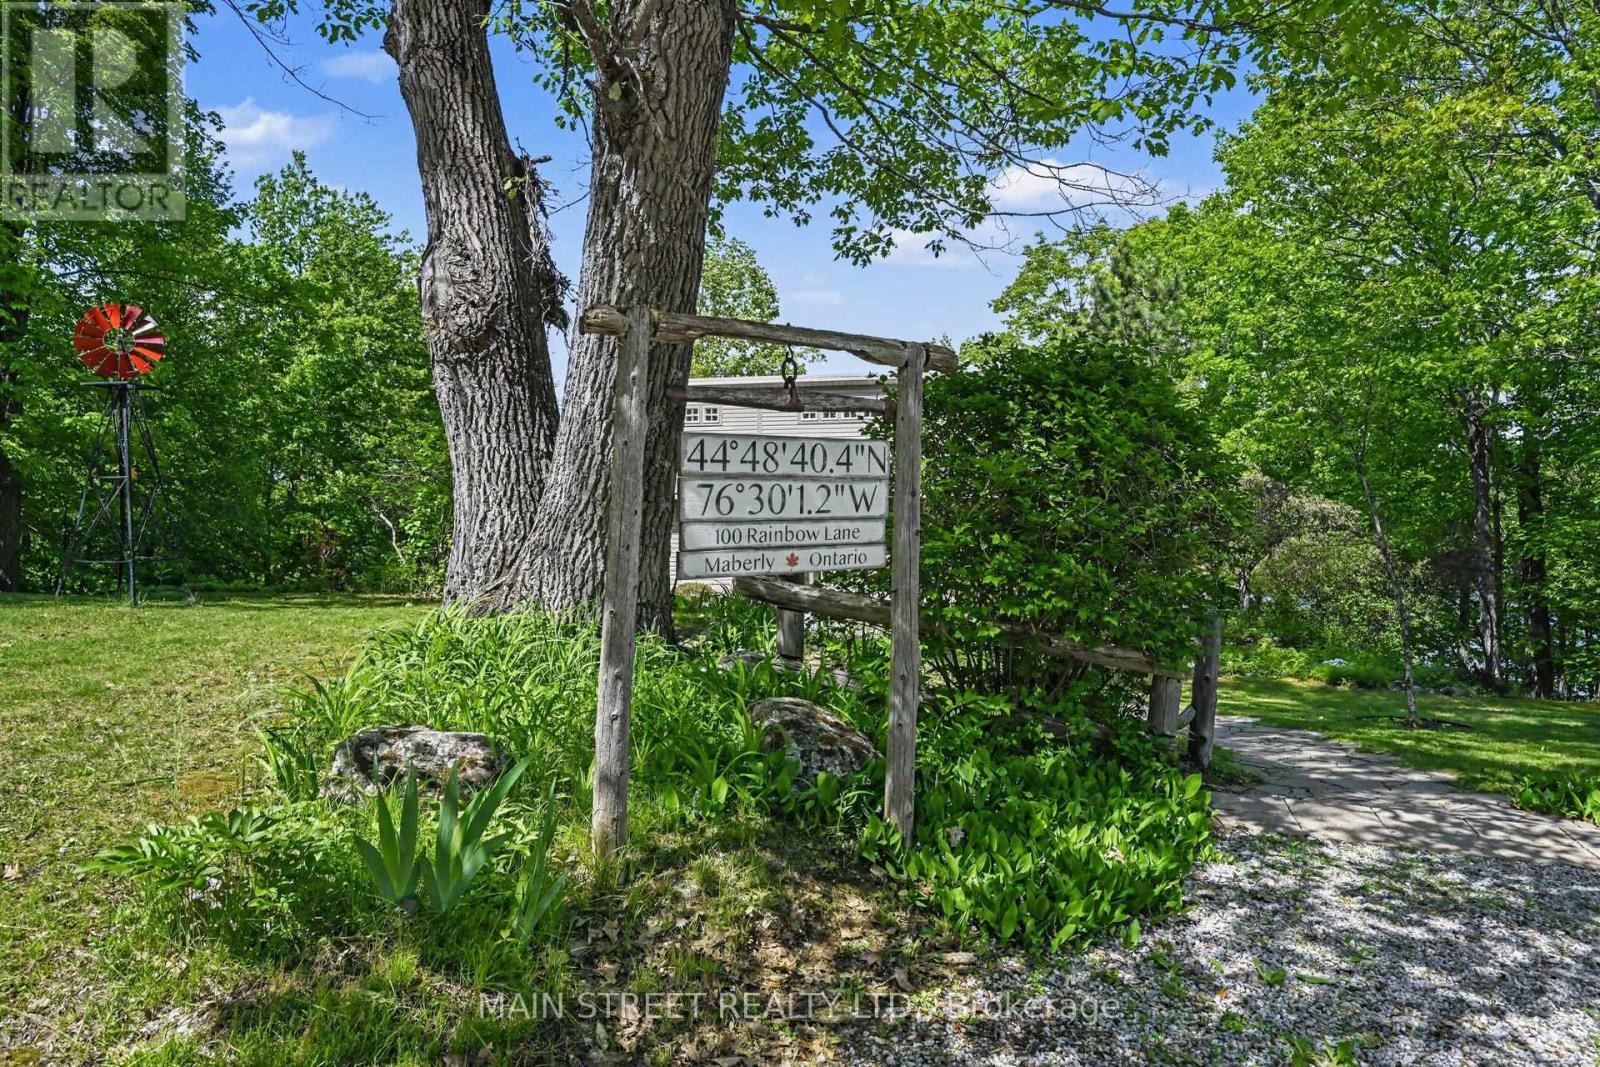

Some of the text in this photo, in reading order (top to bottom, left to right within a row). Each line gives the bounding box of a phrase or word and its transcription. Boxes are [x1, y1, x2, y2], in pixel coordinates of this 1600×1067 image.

[715, 525, 861, 545] 100 Rainbow Lane
[705, 549, 868, 573] Maberly Ontario
